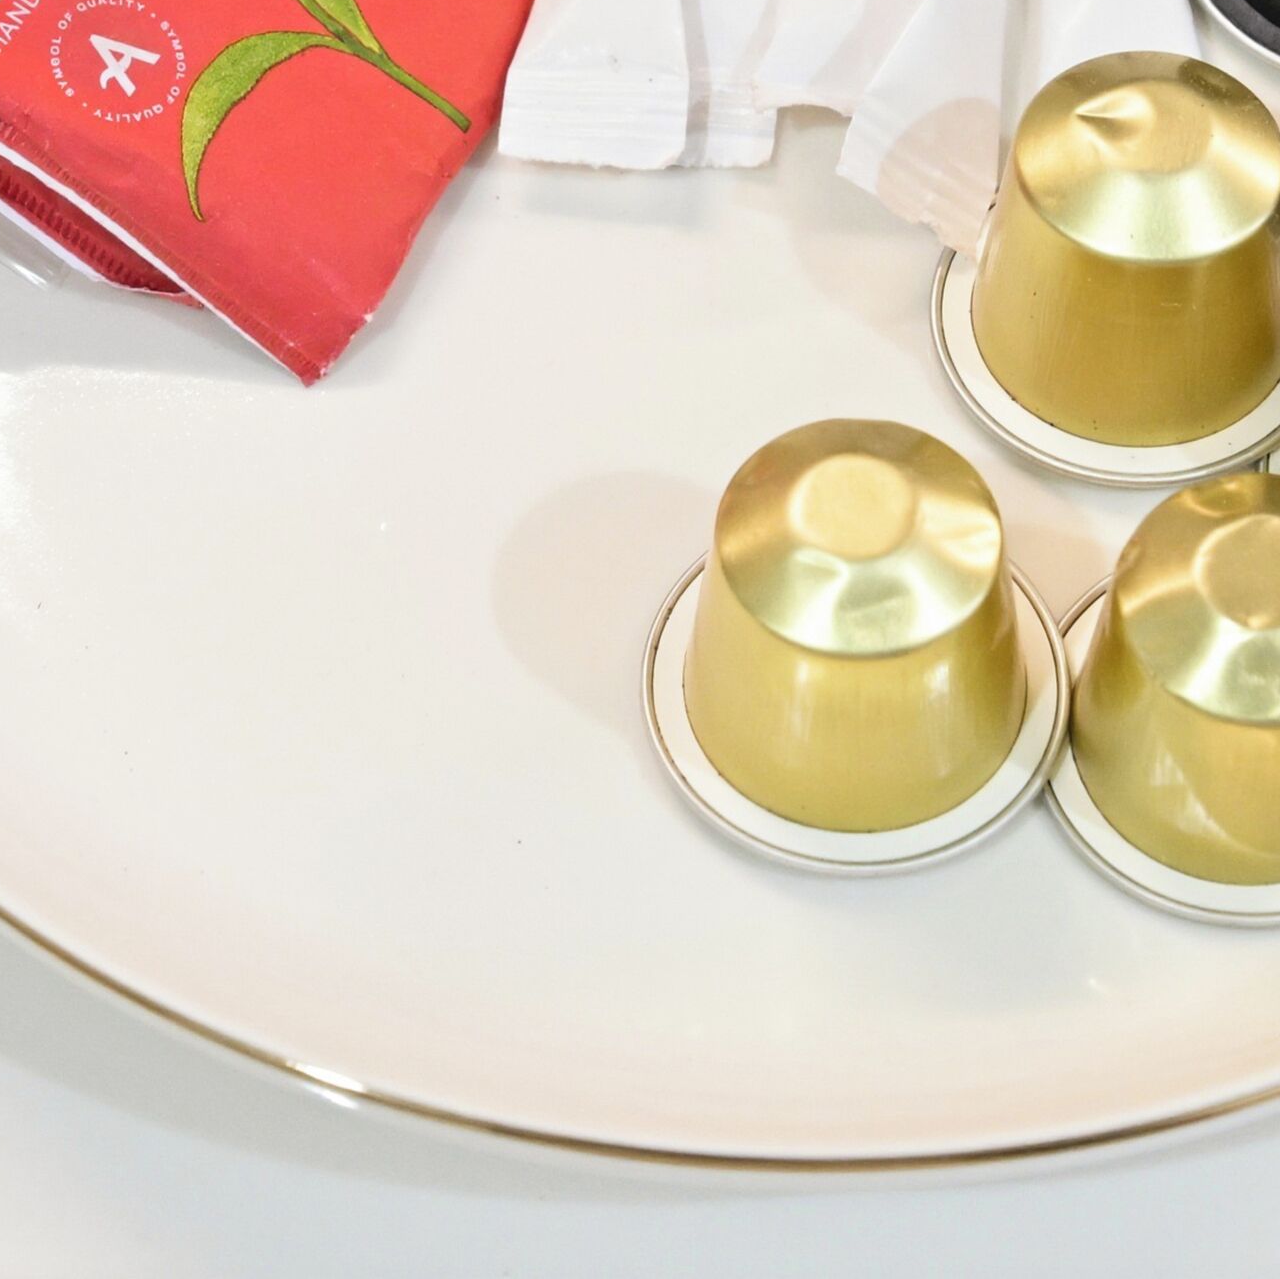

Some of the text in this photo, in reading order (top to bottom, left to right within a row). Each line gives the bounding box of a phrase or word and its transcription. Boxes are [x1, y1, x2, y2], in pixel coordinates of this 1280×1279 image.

[58, 12, 72, 31] OF
[50, 36, 75, 97] SYMBOL
[94, 21, 186, 123] SYMBOL OF QUALITY
